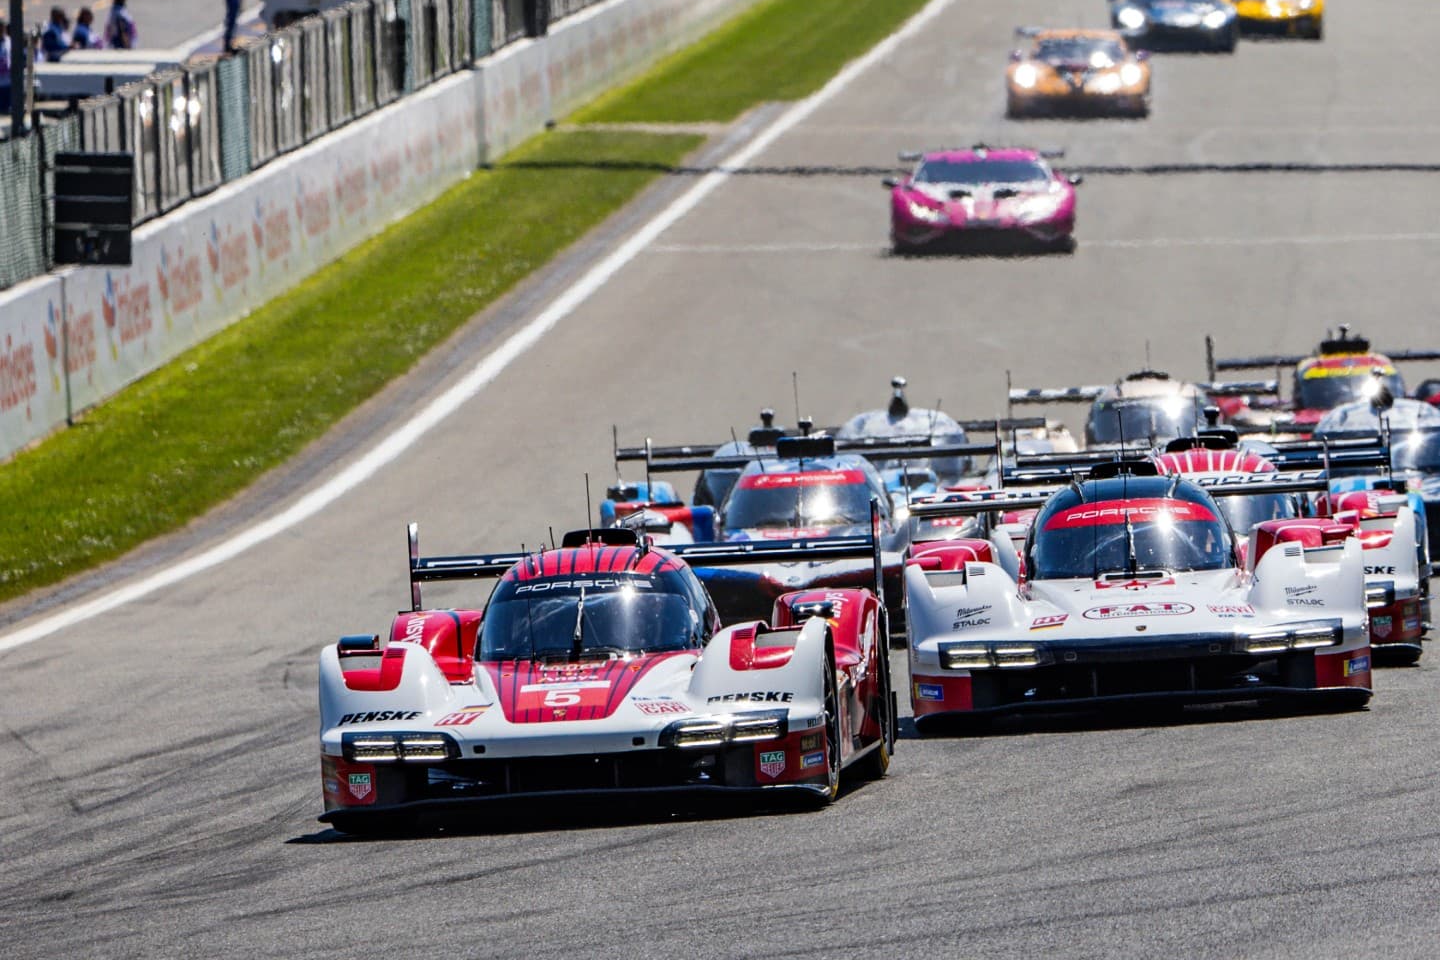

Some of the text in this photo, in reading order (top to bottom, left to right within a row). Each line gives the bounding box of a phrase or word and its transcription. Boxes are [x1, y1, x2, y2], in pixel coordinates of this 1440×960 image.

[1066, 506, 1191, 522] PORSCHE
[1363, 565, 1397, 575] SKE
[516, 579, 653, 595] PORSCHE
[1286, 598, 1325, 607] STALOC
[952, 618, 991, 630] STALOC
[543, 689, 581, 707] 5
[642, 705, 689, 715] CAR
[337, 709, 424, 727] PENSKE
[438, 711, 482, 726] HY
[761, 751, 785, 762] TAG
[350, 774, 371, 784] TAG
